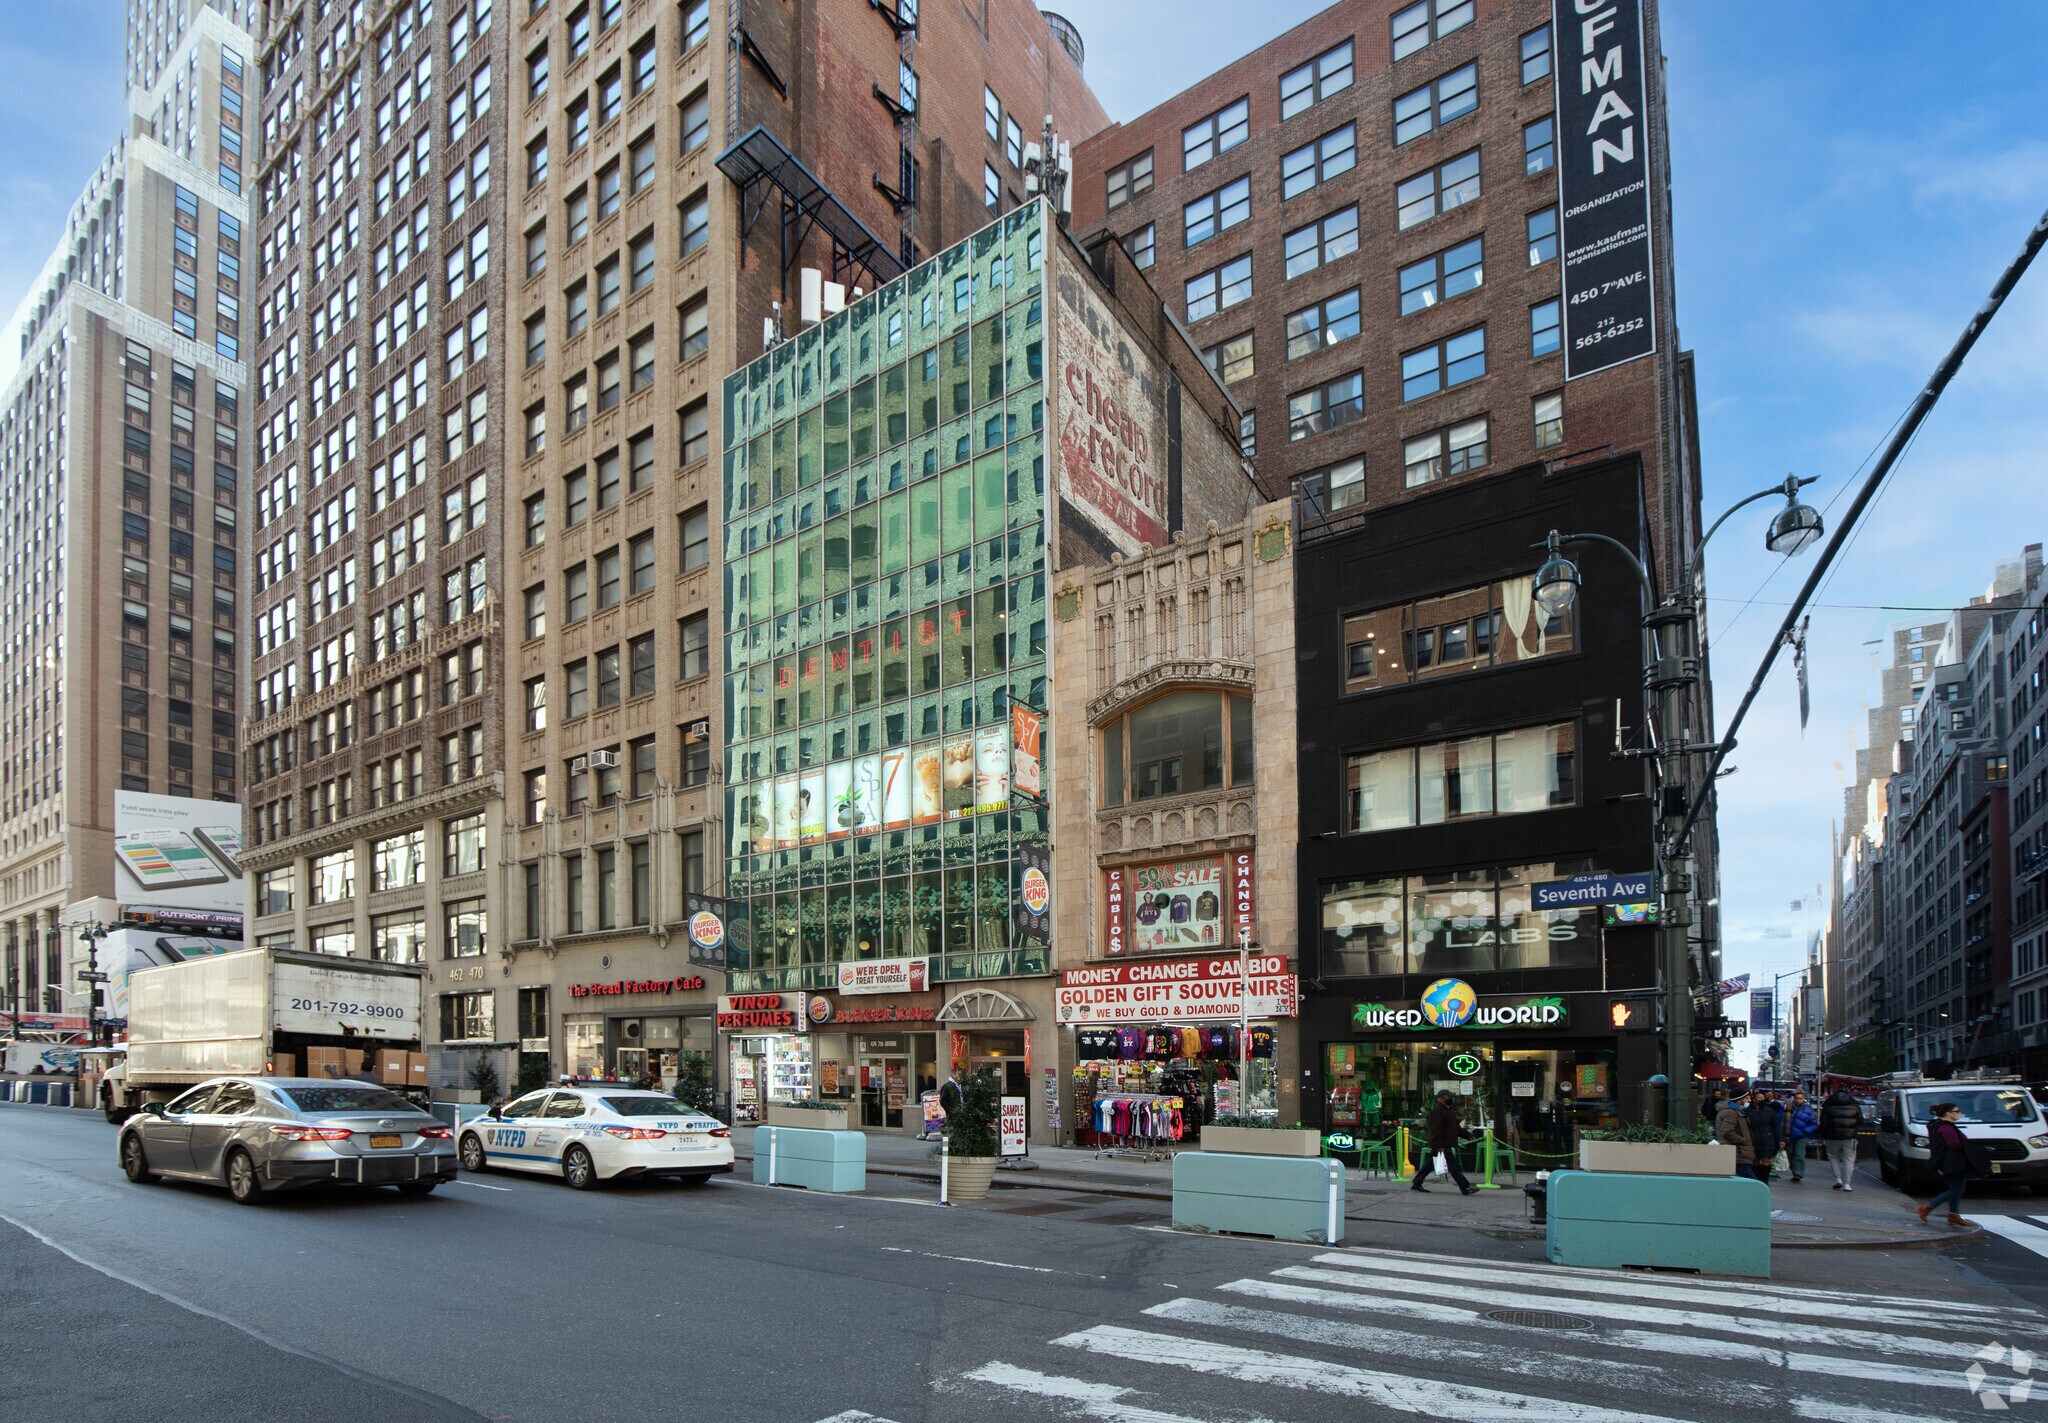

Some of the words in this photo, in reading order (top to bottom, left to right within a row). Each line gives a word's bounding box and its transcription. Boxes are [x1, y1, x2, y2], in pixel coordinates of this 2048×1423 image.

[1565, 180, 1645, 218] ORGANIZATION
[1566, 231, 1647, 267] organization.com
[1567, 223, 1645, 259] www.kaufman
[1570, 287, 1599, 305] 450
[1597, 316, 1615, 329] 212
[1576, 317, 1644, 350] 563-6252
[779, 609, 967, 690] DENTIST
[1027, 717, 1040, 754] 7
[882, 751, 905, 813] 7
[121, 804, 138, 812] Fold
[158, 807, 173, 815] into
[173, 808, 189, 817] play
[949, 809, 962, 819] TEL.
[1173, 858, 1215, 872] REDUCED
[1024, 879, 1046, 889] BURGER
[1137, 866, 1170, 889] 50%
[1154, 878, 1174, 891] OFF
[1173, 867, 1222, 887] SALE
[1574, 874, 1588, 883] 462
[1593, 873, 1608, 881] 480
[1025, 888, 1047, 902] KING
[1538, 884, 1607, 904] Seventh
[1612, 882, 1647, 897] Ave
[693, 919, 719, 930] BURGER
[694, 926, 721, 939] KING
[1445, 924, 1579, 949] LABS
[449, 968, 464, 981] 462
[469, 966, 484, 979] 470
[855, 965, 878, 977] WE'RE
[880, 964, 902, 975] OPEN.
[1066, 967, 1122, 985] MONEY
[1129, 962, 1199, 982] CHANGE
[855, 976, 875, 985] TREAT
[875, 974, 908, 984] YOURSELF.
[568, 984, 586, 997] The
[589, 981, 622, 995] Bread
[625, 980, 670, 995] Factory
[1060, 987, 1127, 1005] GOLDEN
[1133, 985, 1174, 1002] GIFT
[1179, 978, 1289, 1000] SOUVENIRS
[291, 998, 404, 1019] 201-792-9900
[728, 994, 780, 1010] VINOD
[1275, 1005, 1290, 1013] NY
[717, 1010, 792, 1027] PERFUMES
[811, 1005, 827, 1016] KING
[835, 1008, 892, 1023] BURGER
[895, 1006, 934, 1021] KING
[1096, 1008, 1111, 1018] WE
[1115, 1007, 1136, 1017] BUY
[1140, 1006, 1169, 1016] GOLD
[1173, 1005, 1182, 1016] &
[1366, 1008, 1422, 1027] WEED
[1476, 1005, 1560, 1024] WORLD
[1253, 1032, 1270, 1040] NYPD
[1714, 1027, 1746, 1038] BAR
[960, 1035, 967, 1054] 7
[737, 1067, 752, 1075] 50%
[1002, 1104, 1024, 1116] SAMPLE
[1002, 1118, 1024, 1135] SALE
[495, 1128, 526, 1148] NYPD
[1328, 1136, 1353, 1145] ATM
